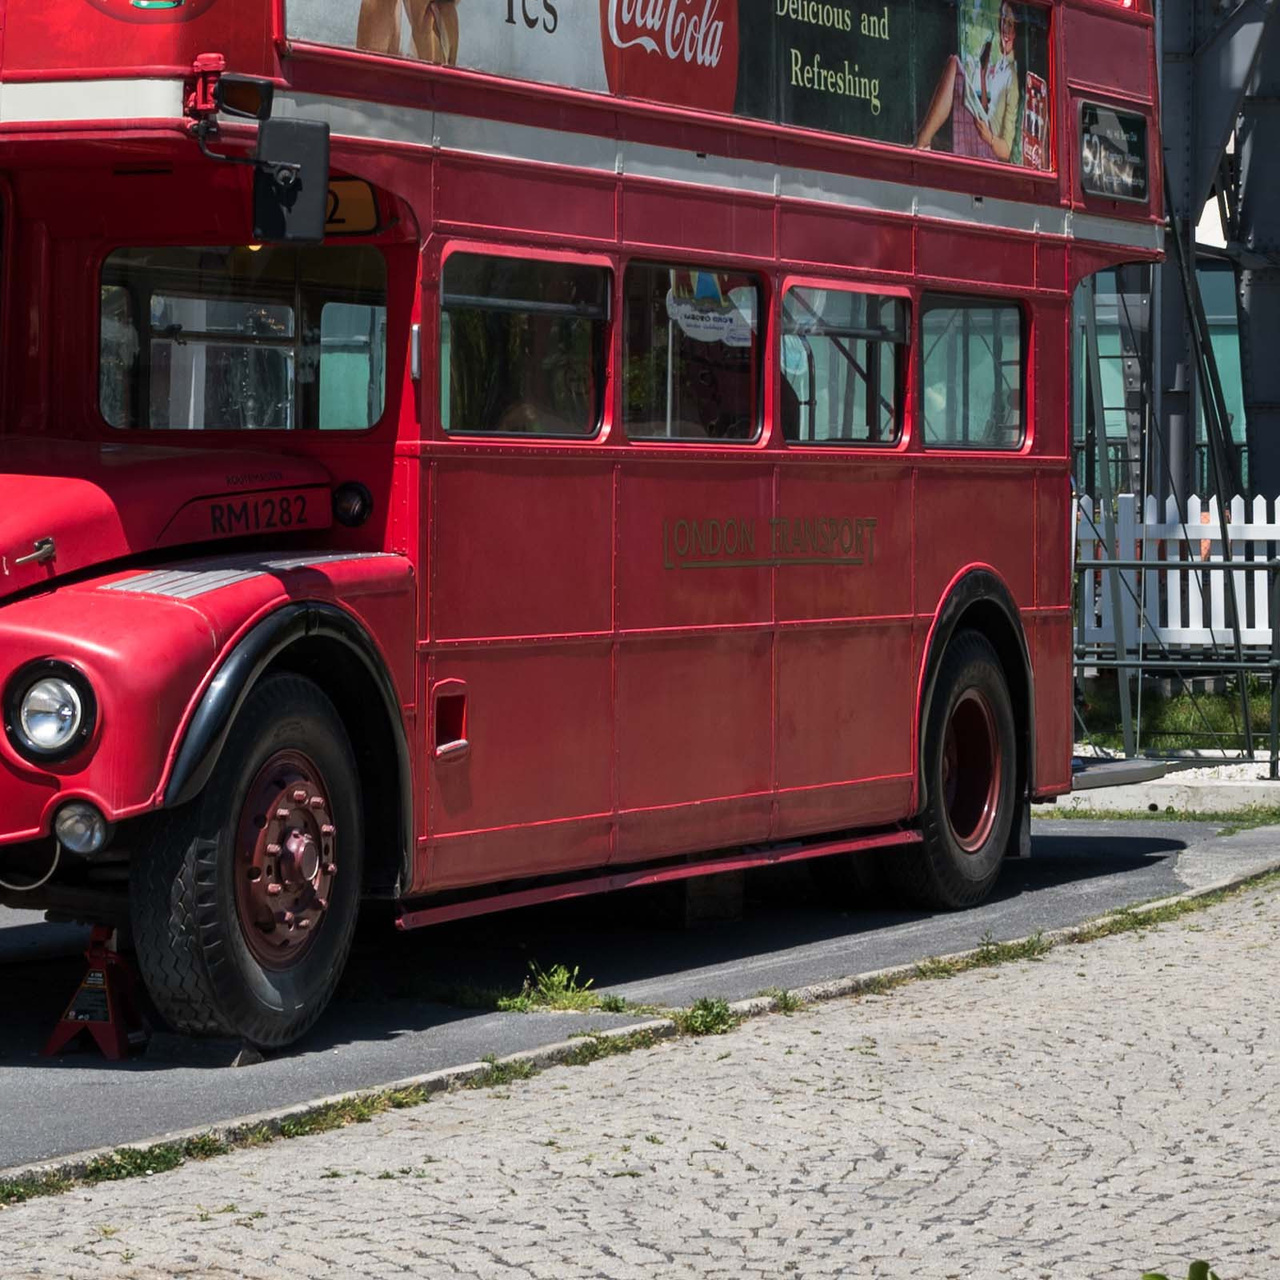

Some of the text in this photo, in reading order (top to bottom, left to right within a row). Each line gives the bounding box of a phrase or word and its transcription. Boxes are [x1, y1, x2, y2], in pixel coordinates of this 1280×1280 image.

[860, 6, 890, 41] and
[790, 47, 881, 116] Refreshing
[210, 495, 308, 535] RM1282
[662, 516, 878, 569] LONDON TRANSPORT
